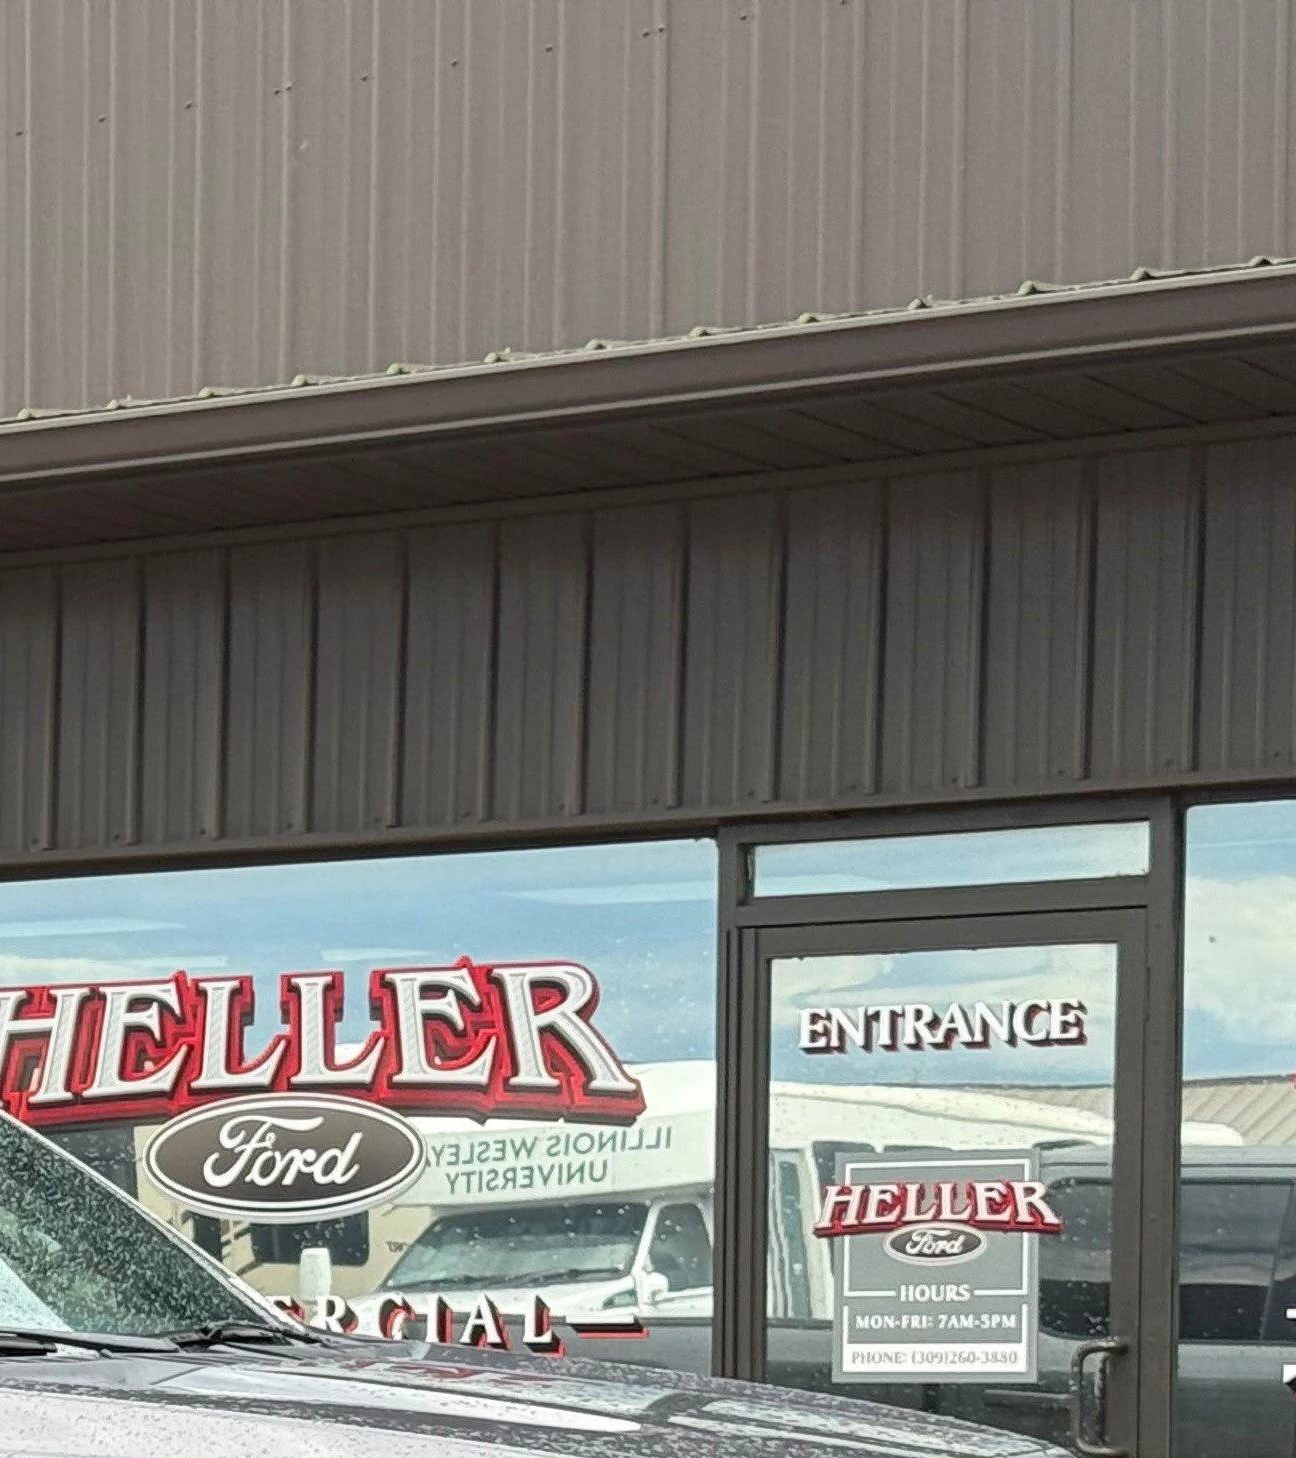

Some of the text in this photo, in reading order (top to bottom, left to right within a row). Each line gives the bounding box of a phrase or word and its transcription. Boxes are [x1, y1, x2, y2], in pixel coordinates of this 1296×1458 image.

[798, 999, 1088, 1053] ENTRANCE
[204, 1114, 361, 1188] Ford
[814, 1179, 1065, 1237] HELLER
[905, 1229, 964, 1256] Ford
[900, 1283, 972, 1302] HOURS
[855, 1313, 1018, 1329] MON-FRI: 7AM-5PM
[851, 1351, 907, 1365] PHONE:
